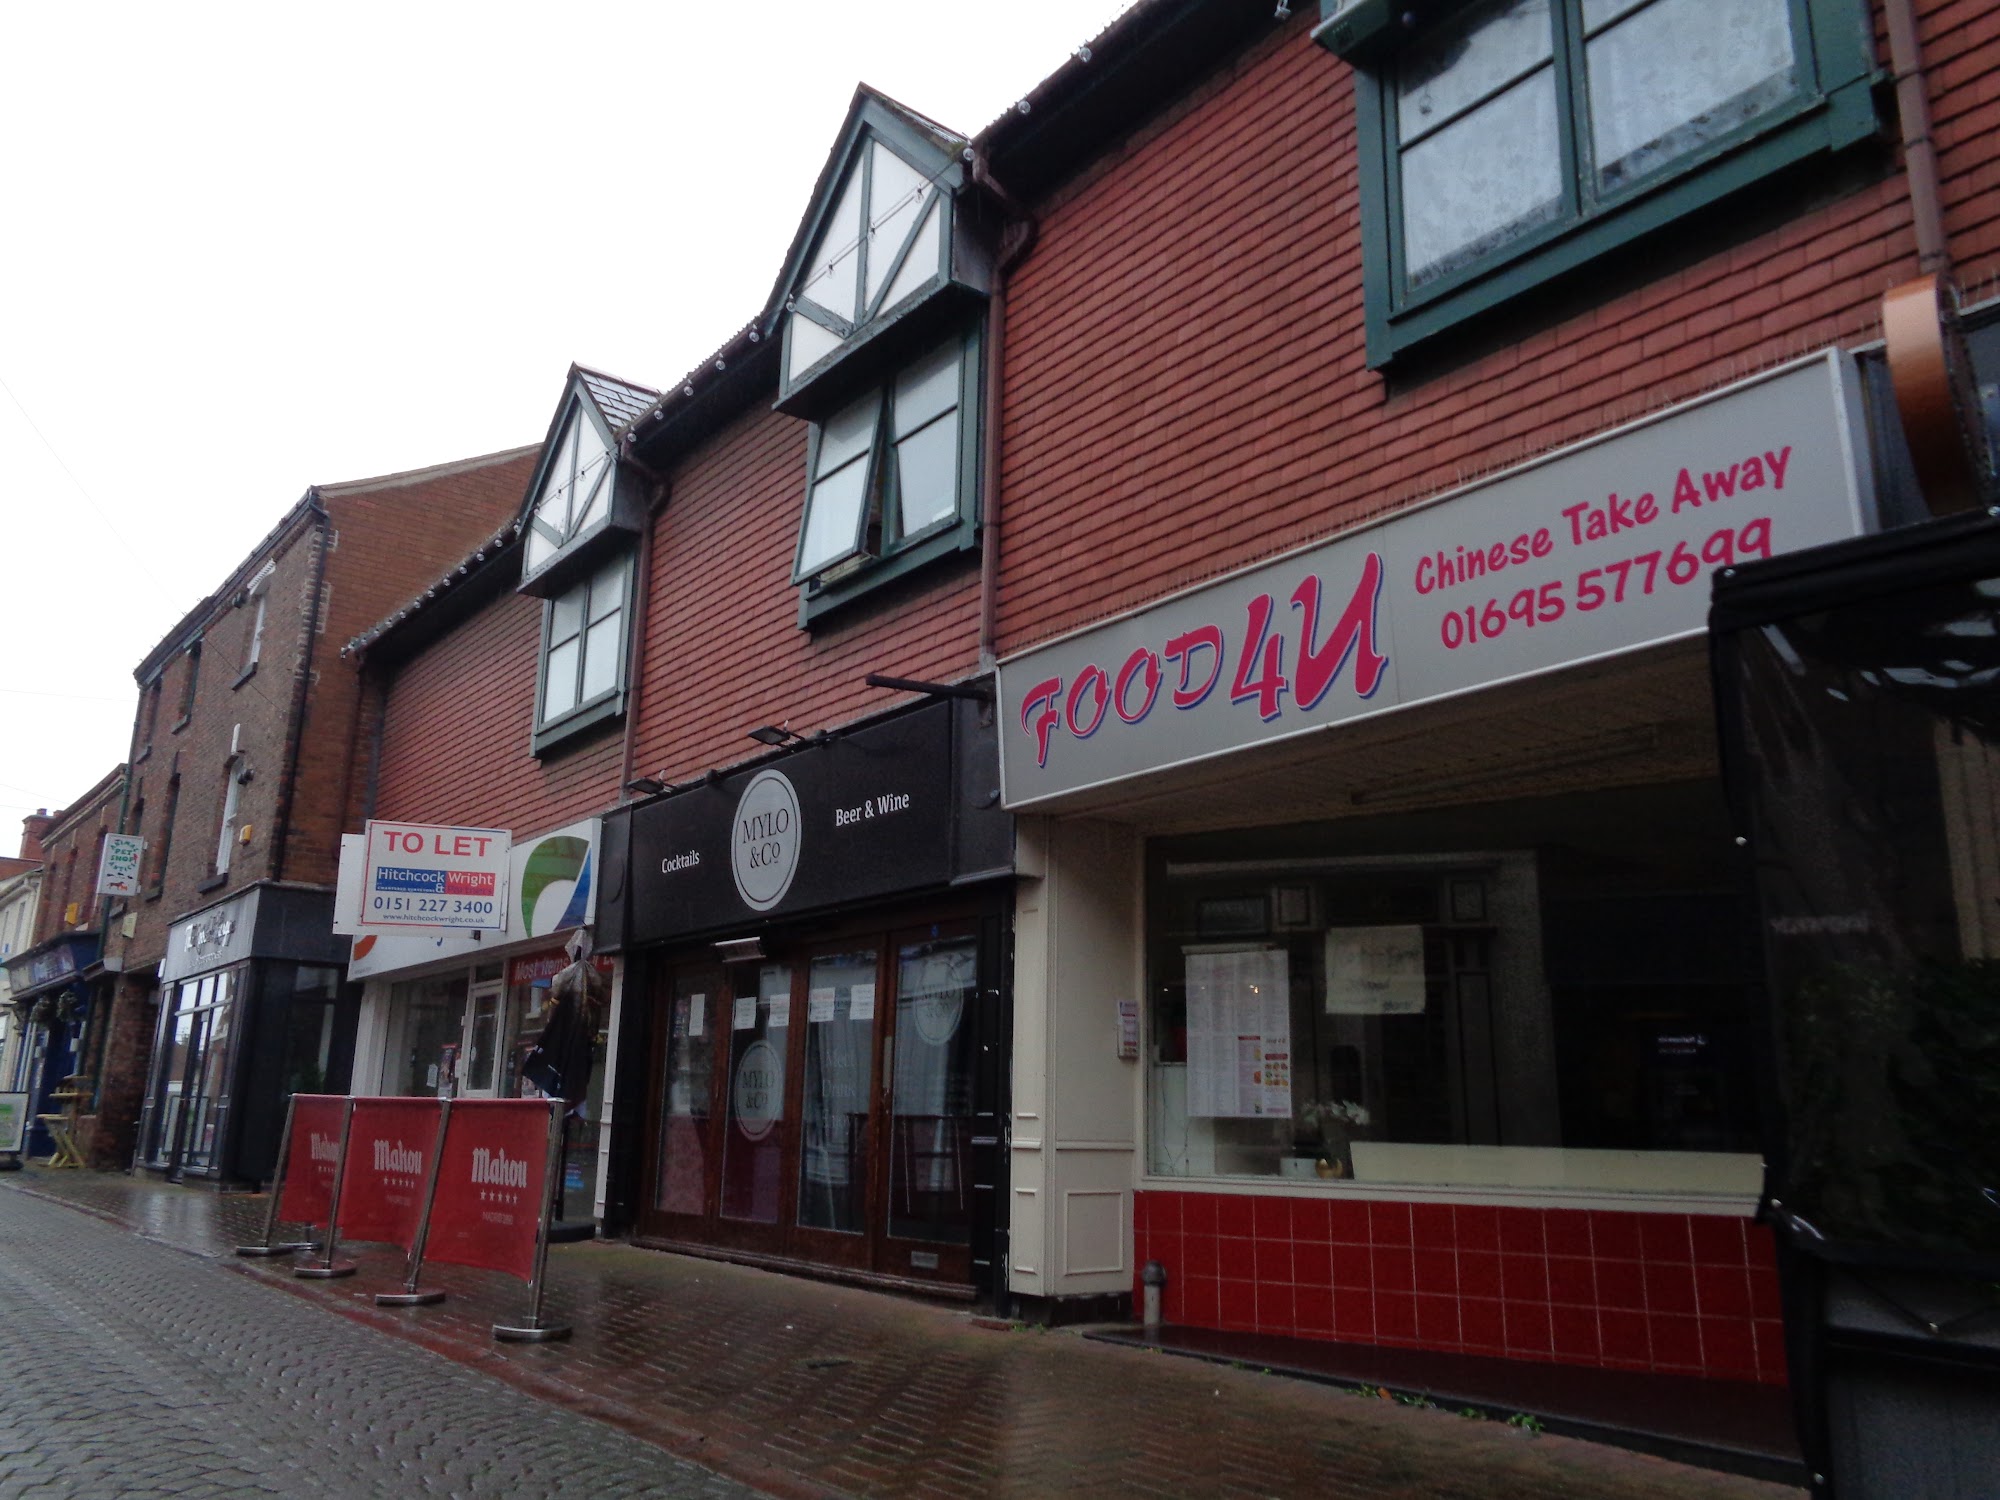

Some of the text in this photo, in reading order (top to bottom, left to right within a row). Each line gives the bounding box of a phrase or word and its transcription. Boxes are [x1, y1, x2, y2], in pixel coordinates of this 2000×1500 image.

[1414, 445, 1793, 595] Chinese Take Away
[1440, 516, 1774, 650] 01695 577699
[835, 793, 910, 828] Beer & Wine
[742, 808, 789, 845] MYLO
[115, 848, 133, 856] PET
[383, 831, 492, 858] TO LET
[111, 854, 135, 862] SHOP
[661, 849, 700, 875] Cocktails
[377, 867, 493, 886] Hitchcock Wright
[435, 882, 445, 893] &
[374, 896, 493, 913] 0151 227 3400
[383, 914, 485, 924] www.hitchcockwright.co.uk
[515, 958, 538, 981] Most
[742, 1070, 775, 1088] MYLO
[373, 1139, 422, 1176] Mahou
[471, 1147, 527, 1189] Mahou
